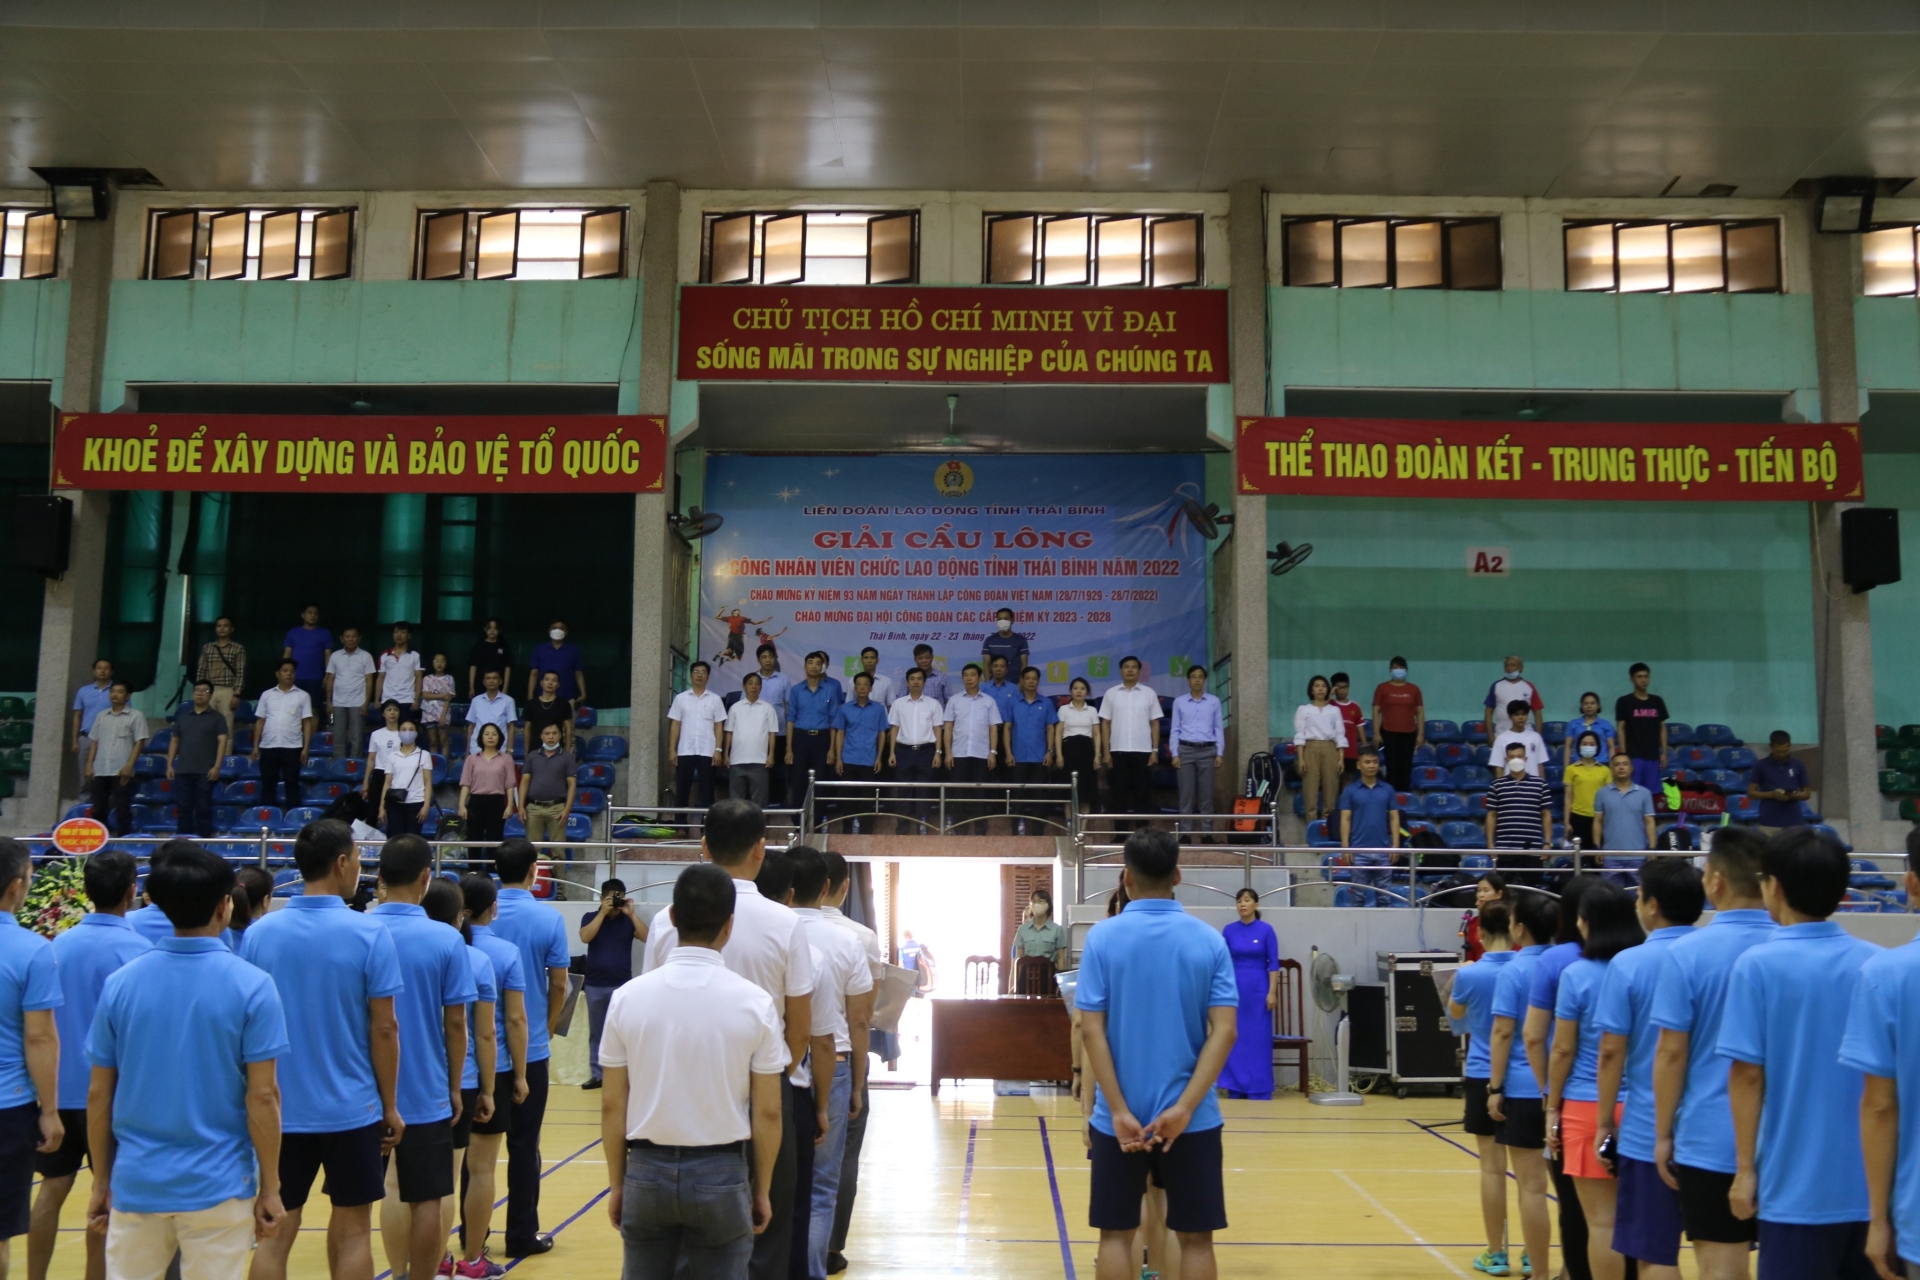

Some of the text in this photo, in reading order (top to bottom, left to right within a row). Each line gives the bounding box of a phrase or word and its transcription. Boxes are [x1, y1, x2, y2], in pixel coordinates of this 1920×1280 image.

[732, 297, 1177, 338] CHỦ TỊCH HỒ CHÍ MINH VĨ ĐẠI
[695, 338, 1214, 377] SỐNG MÃI TRONG SỰ NGHIỆP CỦA CHÚNG TA
[82, 423, 641, 483] KHOẺ ĐỂ XÂY DỰNG VÀ BẢO VỆ TỔ QUỐC
[1264, 427, 1838, 491] THỂ THAO ĐOÀN KẾT - TRUNG THỰC - TIẾN BỘ
[803, 504, 1105, 518] LIÊN ĐOÀN LAO ĐỘNG TỈNH THÁI BÌNH
[813, 522, 1094, 550] GIẢI CẦU LÔNG
[729, 554, 1181, 580] CÔNG NHÂN VIÊN CHỨC LAO ĐỘNG TỈNH THÁI BÌNH NĂM 2022
[1474, 551, 1503, 573] A2
[750, 587, 773, 601] CHÀO
[775, 587, 802, 601] MỪNG
[804, 585, 816, 601] KỶ
[818, 587, 841, 604] NIỆM
[843, 589, 854, 601] 93
[856, 587, 877, 601] NĂM
[879, 587, 904, 601] NGÀY
[906, 587, 935, 601] THÀNH
[938, 586, 954, 604] LẬP
[957, 587, 982, 602] CÔNG
[984, 587, 1008, 602] ĐOÀN
[1011, 587, 1029, 604] VIỆT
[1032, 589, 1053, 602] NAM
[1055, 589, 1102, 602] (28/7/1929
[1111, 589, 1158, 602] 28/7/2022)
[795, 609, 821, 623] CHÀO
[824, 608, 853, 623] MỪNG
[856, 610, 874, 625] ĐẠI
[876, 609, 893, 625] HỘI
[896, 608, 923, 623] CÔNG
[926, 608, 953, 623] ĐOÀN
[956, 608, 976, 623] CÁC
[1053, 611, 1077, 623] 2023
[1087, 611, 1112, 623] 2028
[869, 631, 887, 641] Thái
[909, 633, 930, 643] ngày
[930, 632, 941, 641] 22
[948, 632, 959, 641] 23
[963, 631, 986, 642] tháng
[226, 758, 235, 768] 15
[1684, 797, 1720, 811] YONEX
[303, 810, 312, 820] 14
[567, 817, 577, 827] 20
